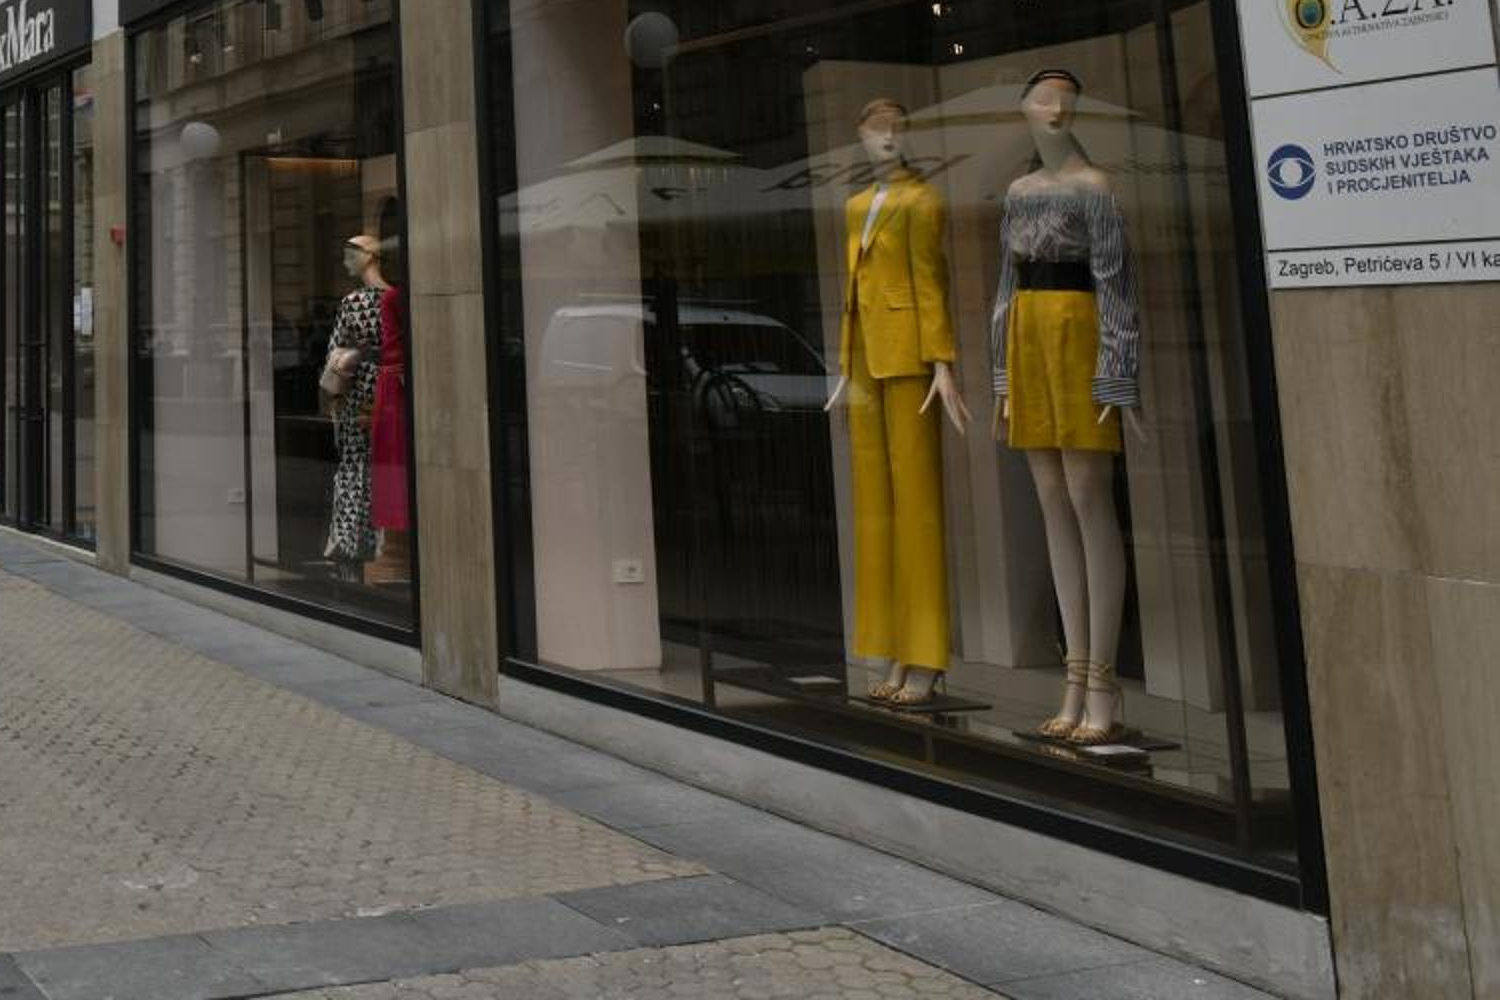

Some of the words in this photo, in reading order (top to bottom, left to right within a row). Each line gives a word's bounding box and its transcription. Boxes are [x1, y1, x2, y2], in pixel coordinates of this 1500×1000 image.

[1323, 135, 1409, 157] HRVATSKO
[1412, 124, 1497, 148] DRUŠTVO
[1325, 155, 1396, 176] SUDSKIH
[1399, 146, 1490, 169] VJEŠTAKA
[1337, 168, 1471, 195] PROCJENITELJA
[1278, 258, 1339, 279] Zagreb,
[1429, 253, 1441, 270] 5
